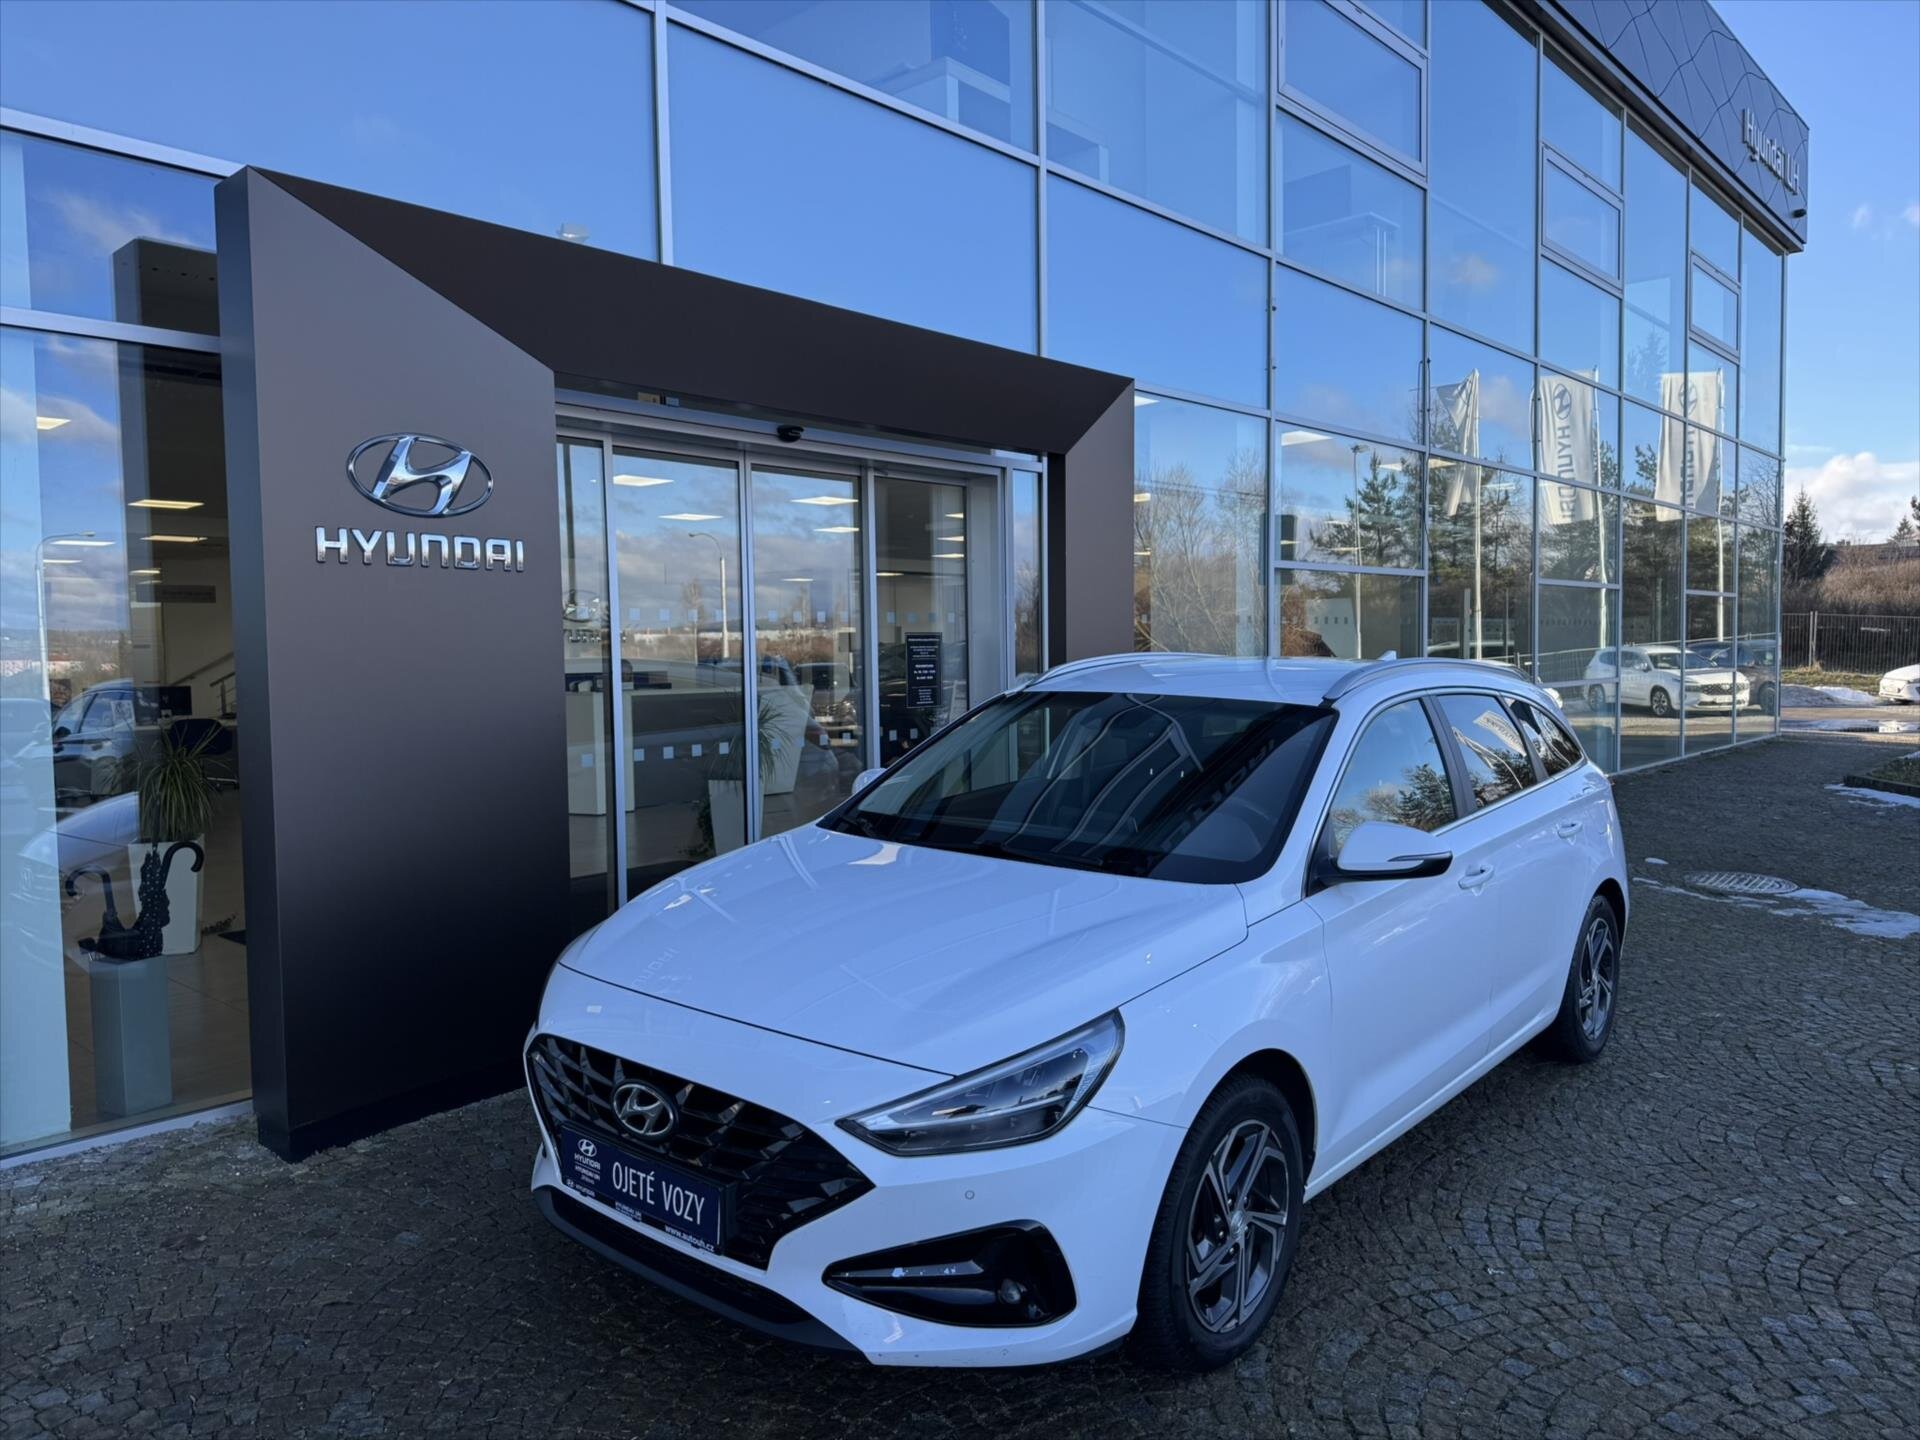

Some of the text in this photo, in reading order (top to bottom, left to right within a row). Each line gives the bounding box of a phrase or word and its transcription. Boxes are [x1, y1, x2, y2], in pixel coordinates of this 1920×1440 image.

[1743, 107, 1784, 180] Hyundai
[315, 526, 525, 572] HYUNDAI
[574, 1152, 601, 1170] HYUNDAI
[612, 1161, 655, 1206] OJETÉ
[661, 1180, 705, 1225] VOZY
